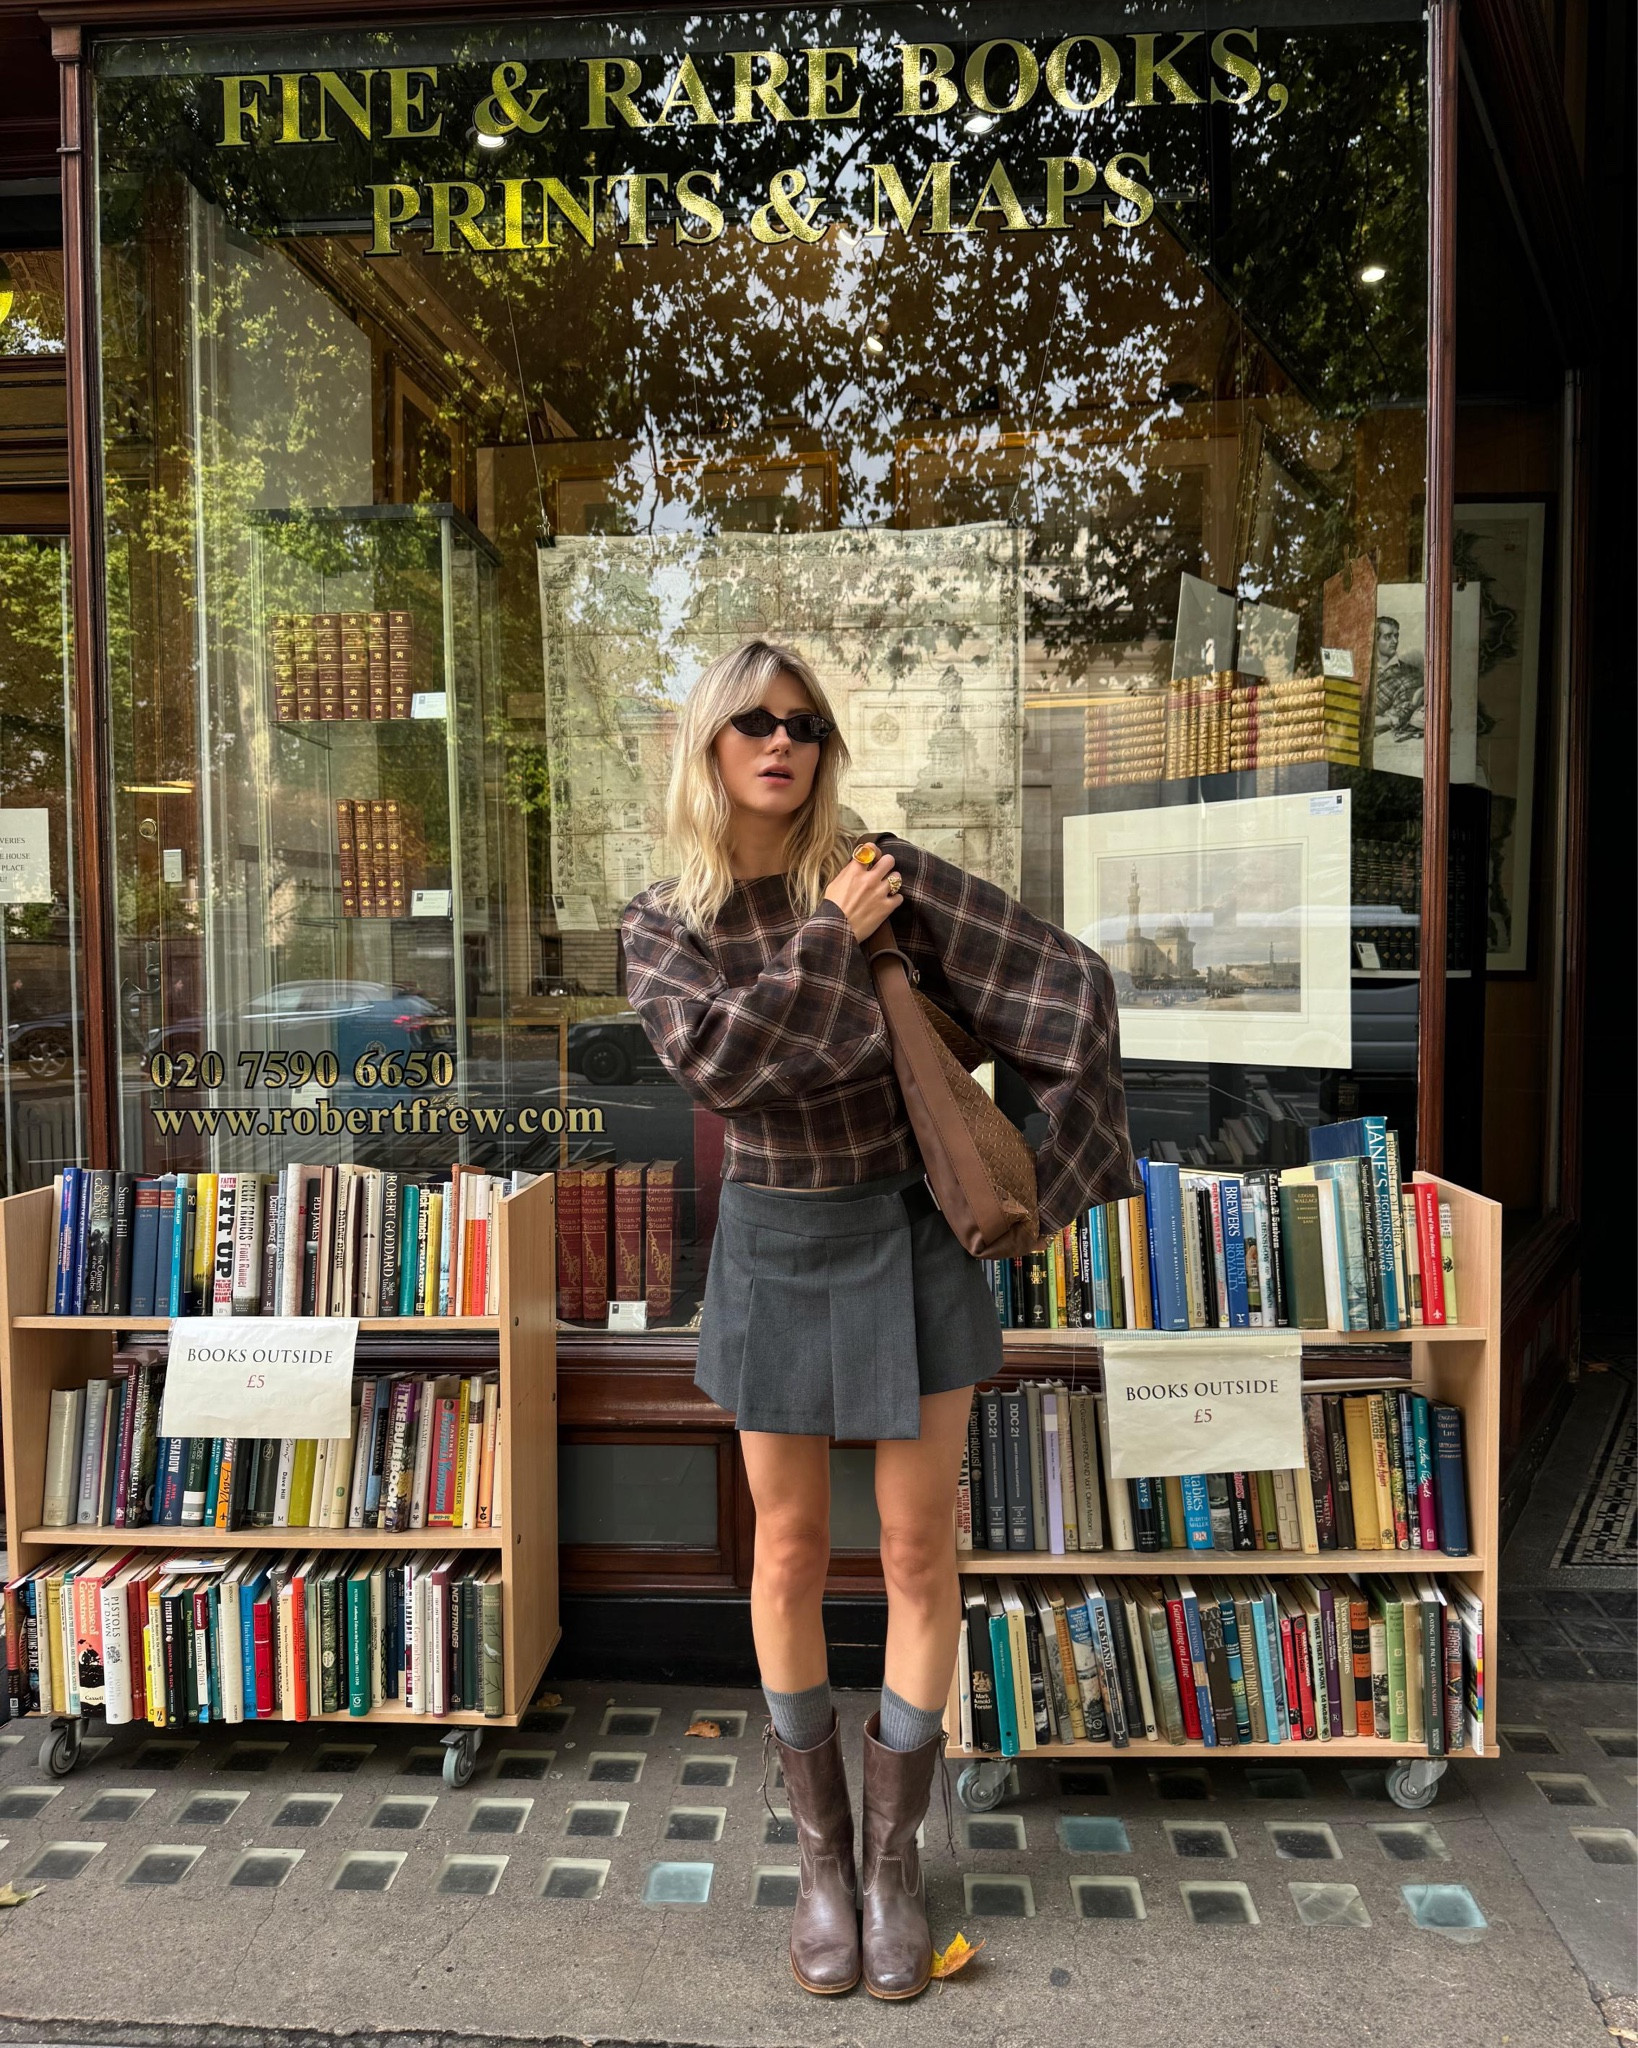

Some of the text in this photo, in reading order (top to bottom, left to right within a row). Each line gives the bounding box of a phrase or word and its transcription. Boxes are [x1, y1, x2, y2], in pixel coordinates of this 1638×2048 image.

[214, 25, 1290, 148] FINE & RARE BOOKS,
[363, 151, 1155, 258] PRINTS & MAPS
[149, 1050, 455, 1089] 020 7590 6650
[151, 1098, 607, 1136] www.robertfrew.com
[1365, 1124, 1387, 1188] JANE'S
[101, 1185, 109, 1218] ROBERT
[116, 1187, 129, 1237] Susan Hill
[239, 1180, 256, 1240] FELIX FRANCIS
[419, 1189, 430, 1207] Dick
[1211, 1183, 1219, 1214] GRANNY
[1225, 1186, 1240, 1237] BREWER'S
[1387, 1140, 1401, 1248] BRITISH COLUMBIA
[217, 1189, 235, 1277] FIT UP
[277, 1197, 286, 1270] ENGLISH FAIRS
[383, 1175, 397, 1276] ROBERT GODDARD
[418, 1210, 429, 1240] Francis
[1213, 1216, 1221, 1231] WAS
[1381, 1194, 1394, 1272] FIGHTING SHIPS
[203, 1229, 211, 1266] WEEKEND
[1428, 1233, 1437, 1258] firedance
[95, 1265, 104, 1292] Corners
[238, 1244, 251, 1288] Front Runner
[1226, 1244, 1238, 1292] ROYALTY
[1236, 1243, 1246, 1285] BRITISH
[387, 1282, 396, 1296] Sight
[187, 1348, 334, 1364] BOOKS OUTSIDE
[125, 1374, 137, 1408] Wisterias
[246, 1374, 265, 1388] £5
[1126, 1379, 1279, 1401] BOOKS OUTSIDE
[361, 1388, 375, 1426] Fanfare
[988, 1404, 998, 1438] DDC 21
[1009, 1403, 1020, 1437] DDC 21
[1194, 1408, 1213, 1424] £5
[1377, 1400, 1385, 1439] REDMOND
[168, 1438, 181, 1473] SHADOW
[386, 1394, 409, 1508] THE BULB BOOK
[970, 1437, 982, 1467] AUGUST
[1375, 1449, 1386, 1468] Trouble
[84, 1473, 92, 1498] HUTTON
[130, 1471, 139, 1498] KELLY
[1377, 1469, 1388, 1487] Again
[962, 1488, 971, 1534] VICTOR GREGG
[1315, 1499, 1323, 1523] ELLIS
[1323, 1495, 1331, 1526] KIRSTEN
[79, 1581, 87, 1634] Greatness
[87, 1582, 99, 1635] Promise of
[104, 1597, 110, 1608] AT
[452, 1587, 458, 1602] NO
[111, 1596, 120, 1637] PISTOLS
[1428, 1612, 1436, 1634] PLAYING
[27, 1618, 38, 1670] NO HIDING PLACE
[195, 1633, 204, 1667] Bermuda
[1095, 1608, 1112, 1670] LAST STAND!
[1172, 1604, 1190, 1678] Gardening on Lime
[1191, 1628, 1200, 1656] TENSION
[1340, 1601, 1352, 1674] Victorian Aspirations
[1239, 1625, 1259, 1706] RHODODENDRONS
[107, 1671, 115, 1705] CAMPBELL
